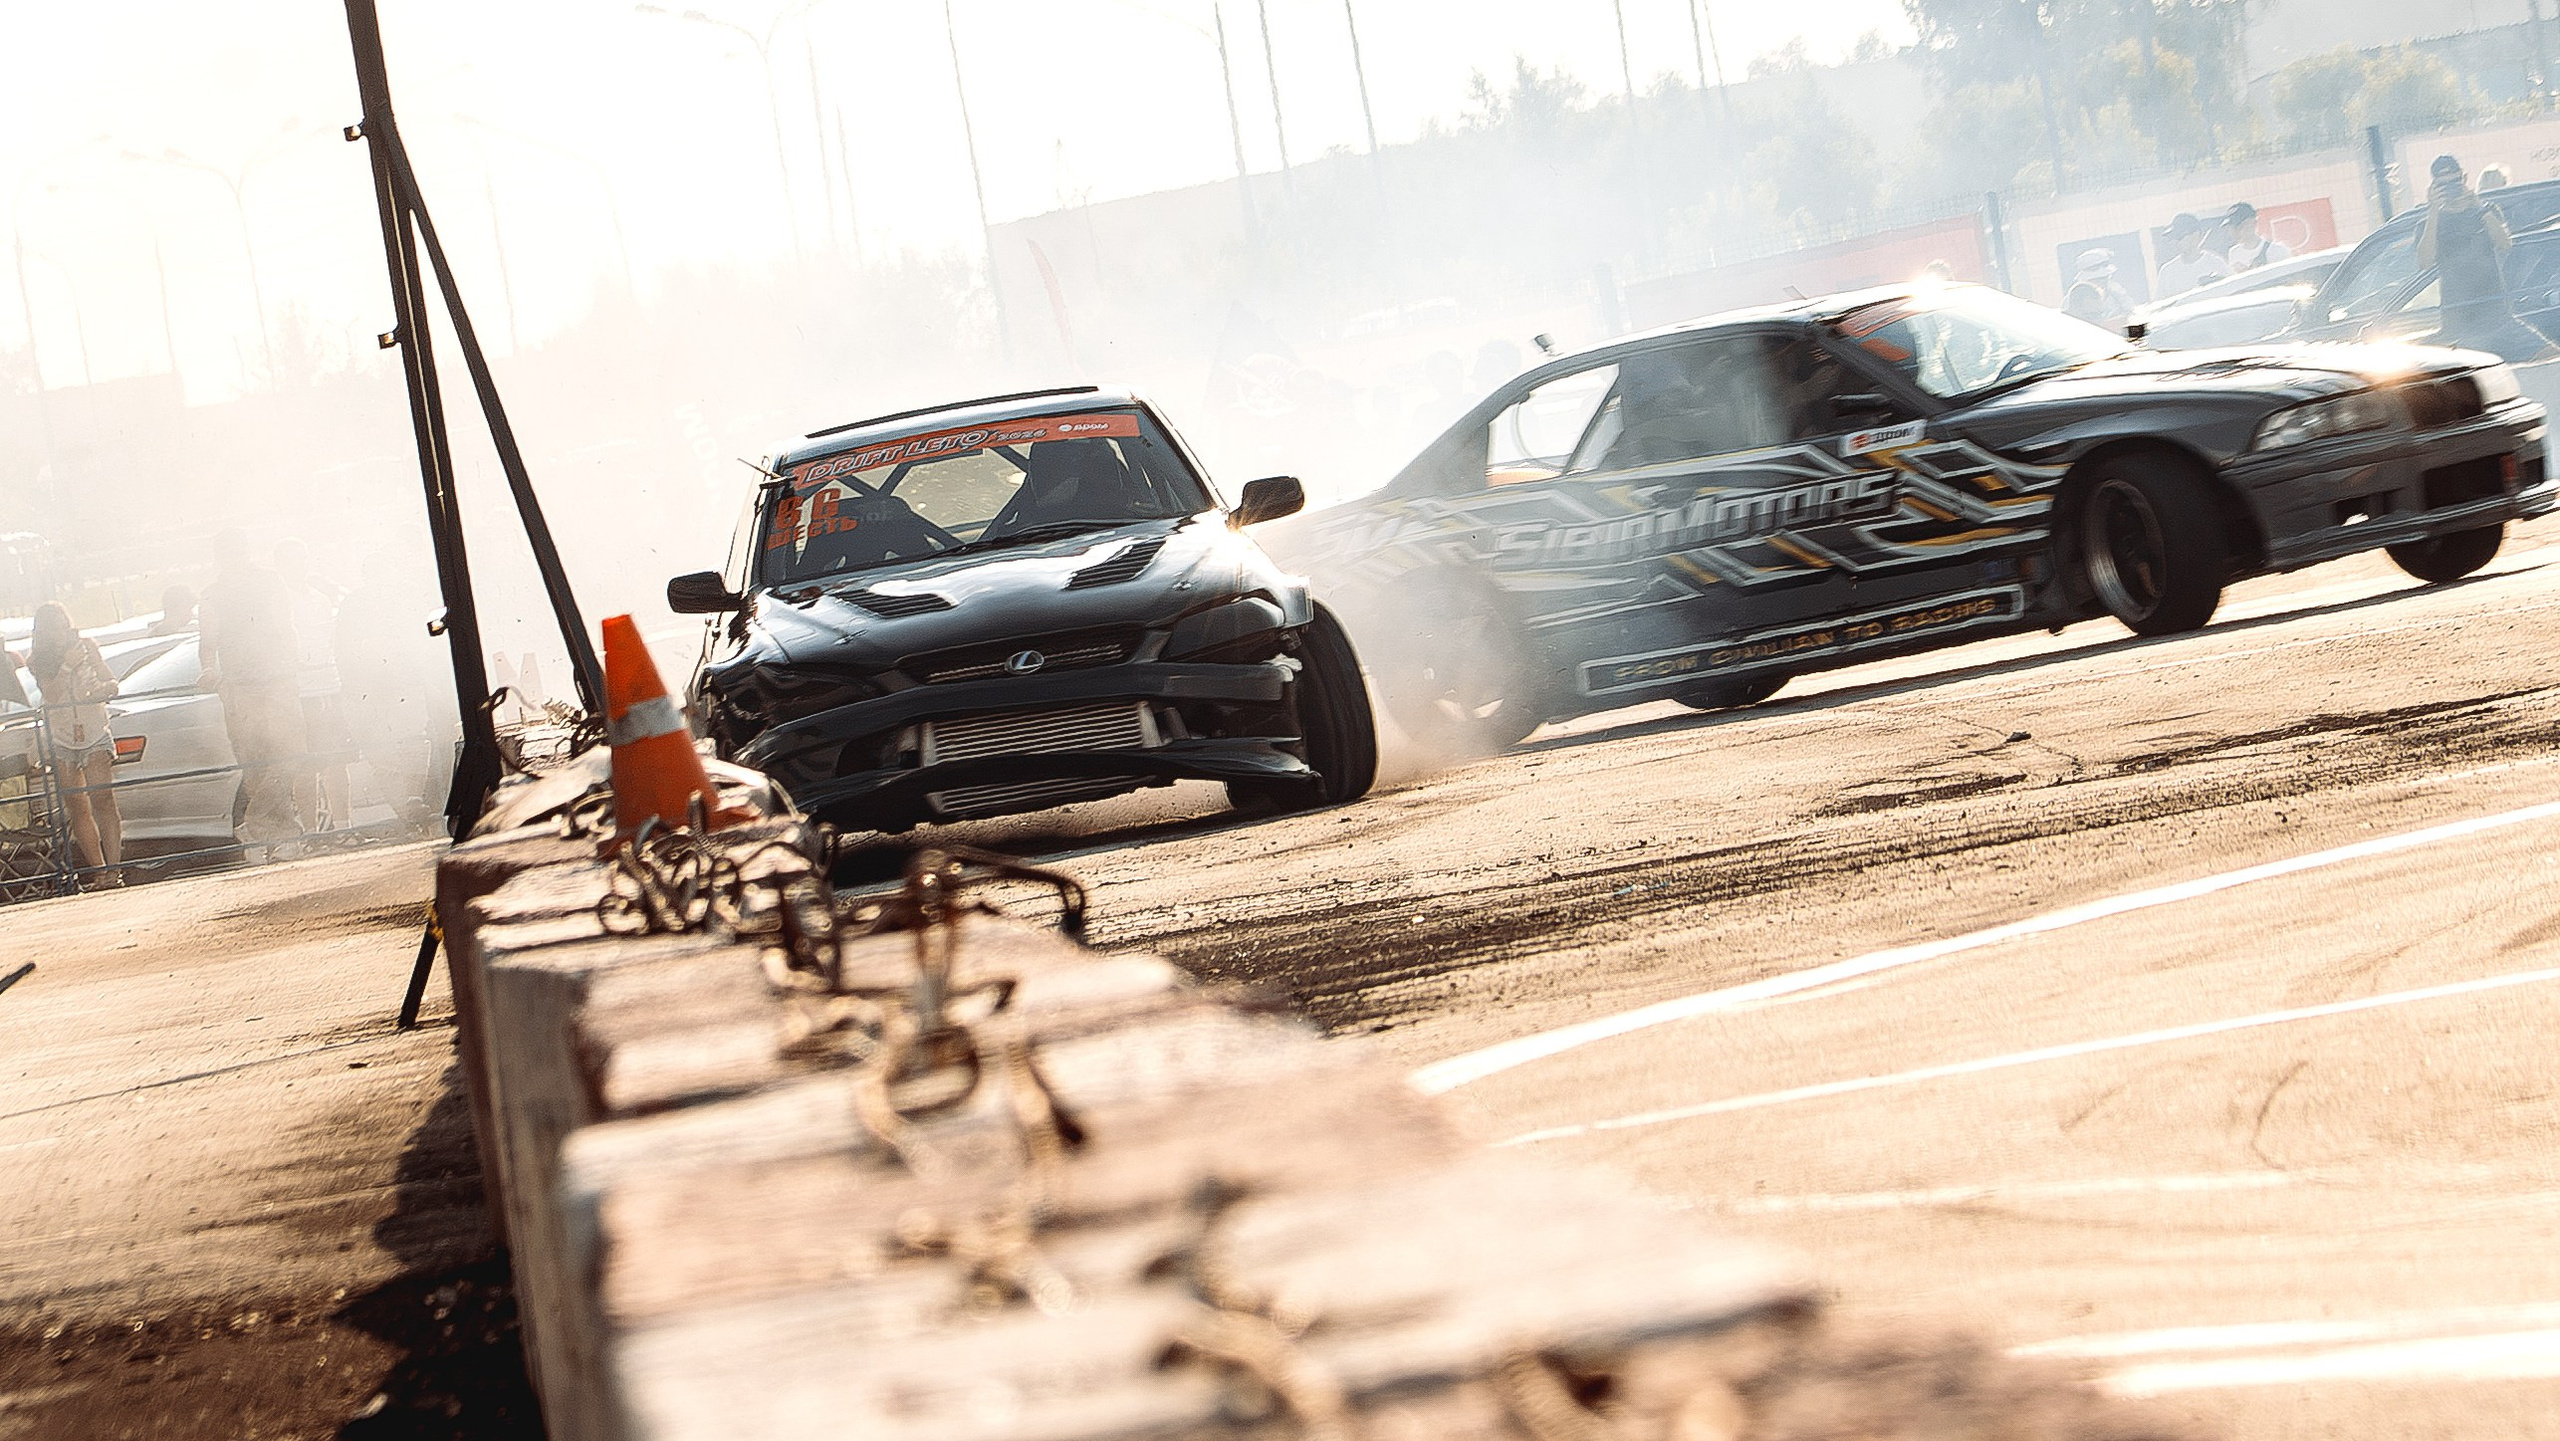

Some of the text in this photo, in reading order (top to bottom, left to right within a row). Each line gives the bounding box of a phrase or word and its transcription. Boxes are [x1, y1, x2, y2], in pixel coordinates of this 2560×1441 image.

[805, 444, 904, 482] DRIFT
[903, 430, 989, 458] LETO
[1844, 622, 1883, 640] TO
